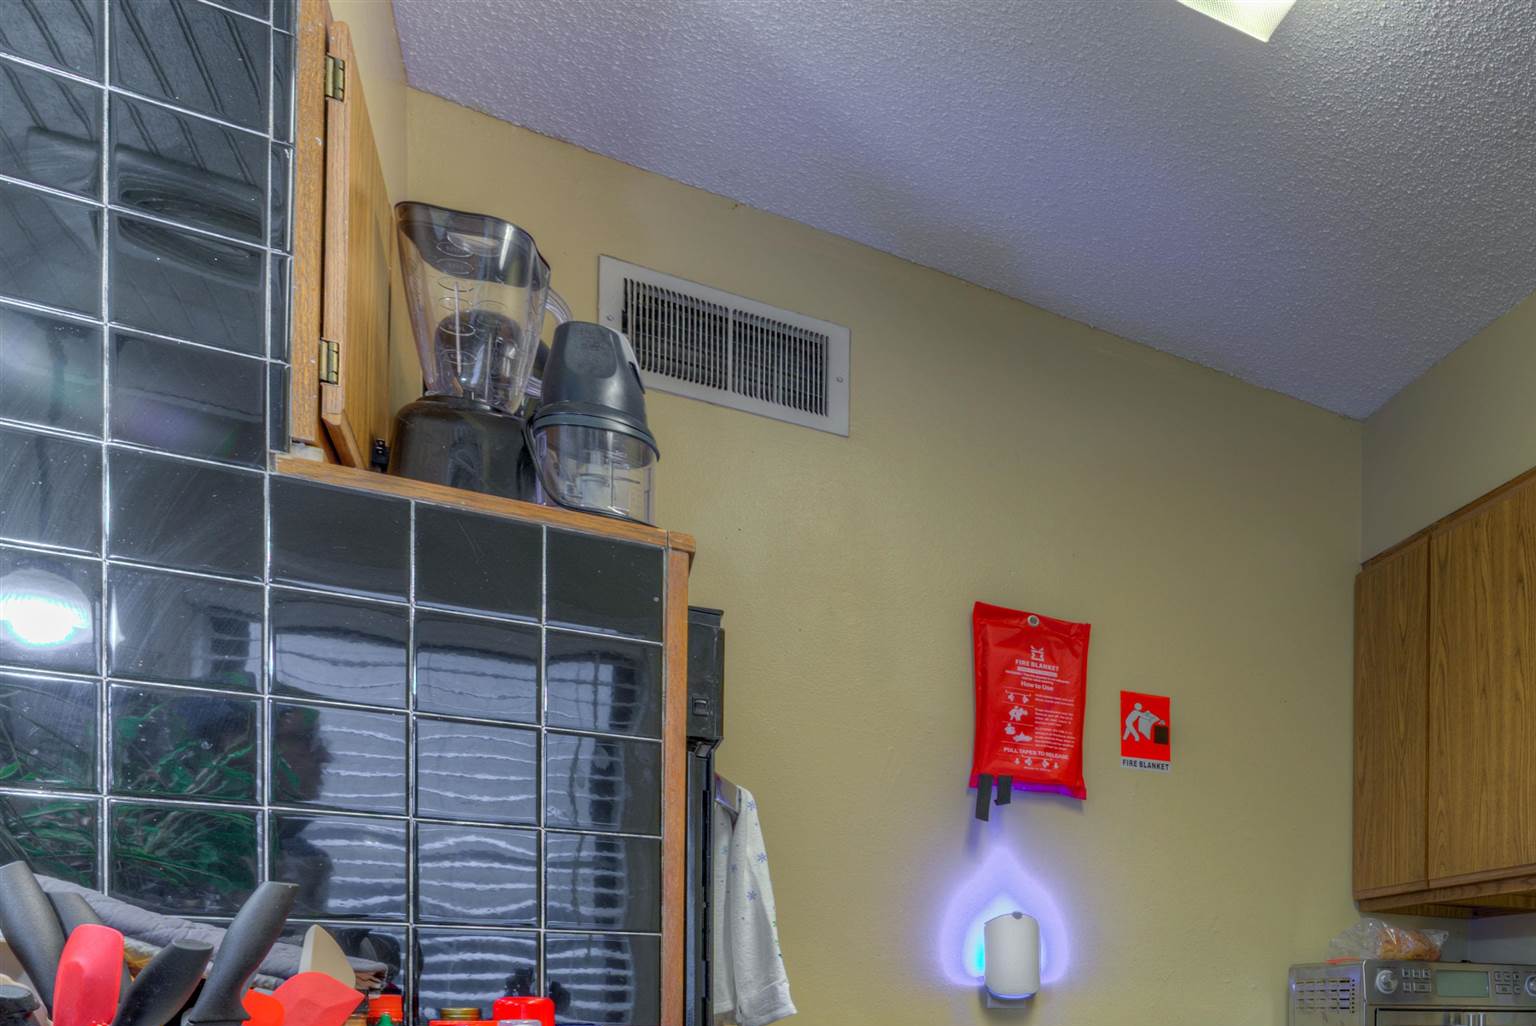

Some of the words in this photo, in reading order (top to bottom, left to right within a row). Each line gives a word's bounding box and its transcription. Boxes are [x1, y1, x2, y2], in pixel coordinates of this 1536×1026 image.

[1015, 659, 1029, 667] FIRE
[1030, 661, 1060, 672] BLANKET
[1122, 759, 1138, 768] FIRE
[1139, 761, 1169, 771] BLANKET
